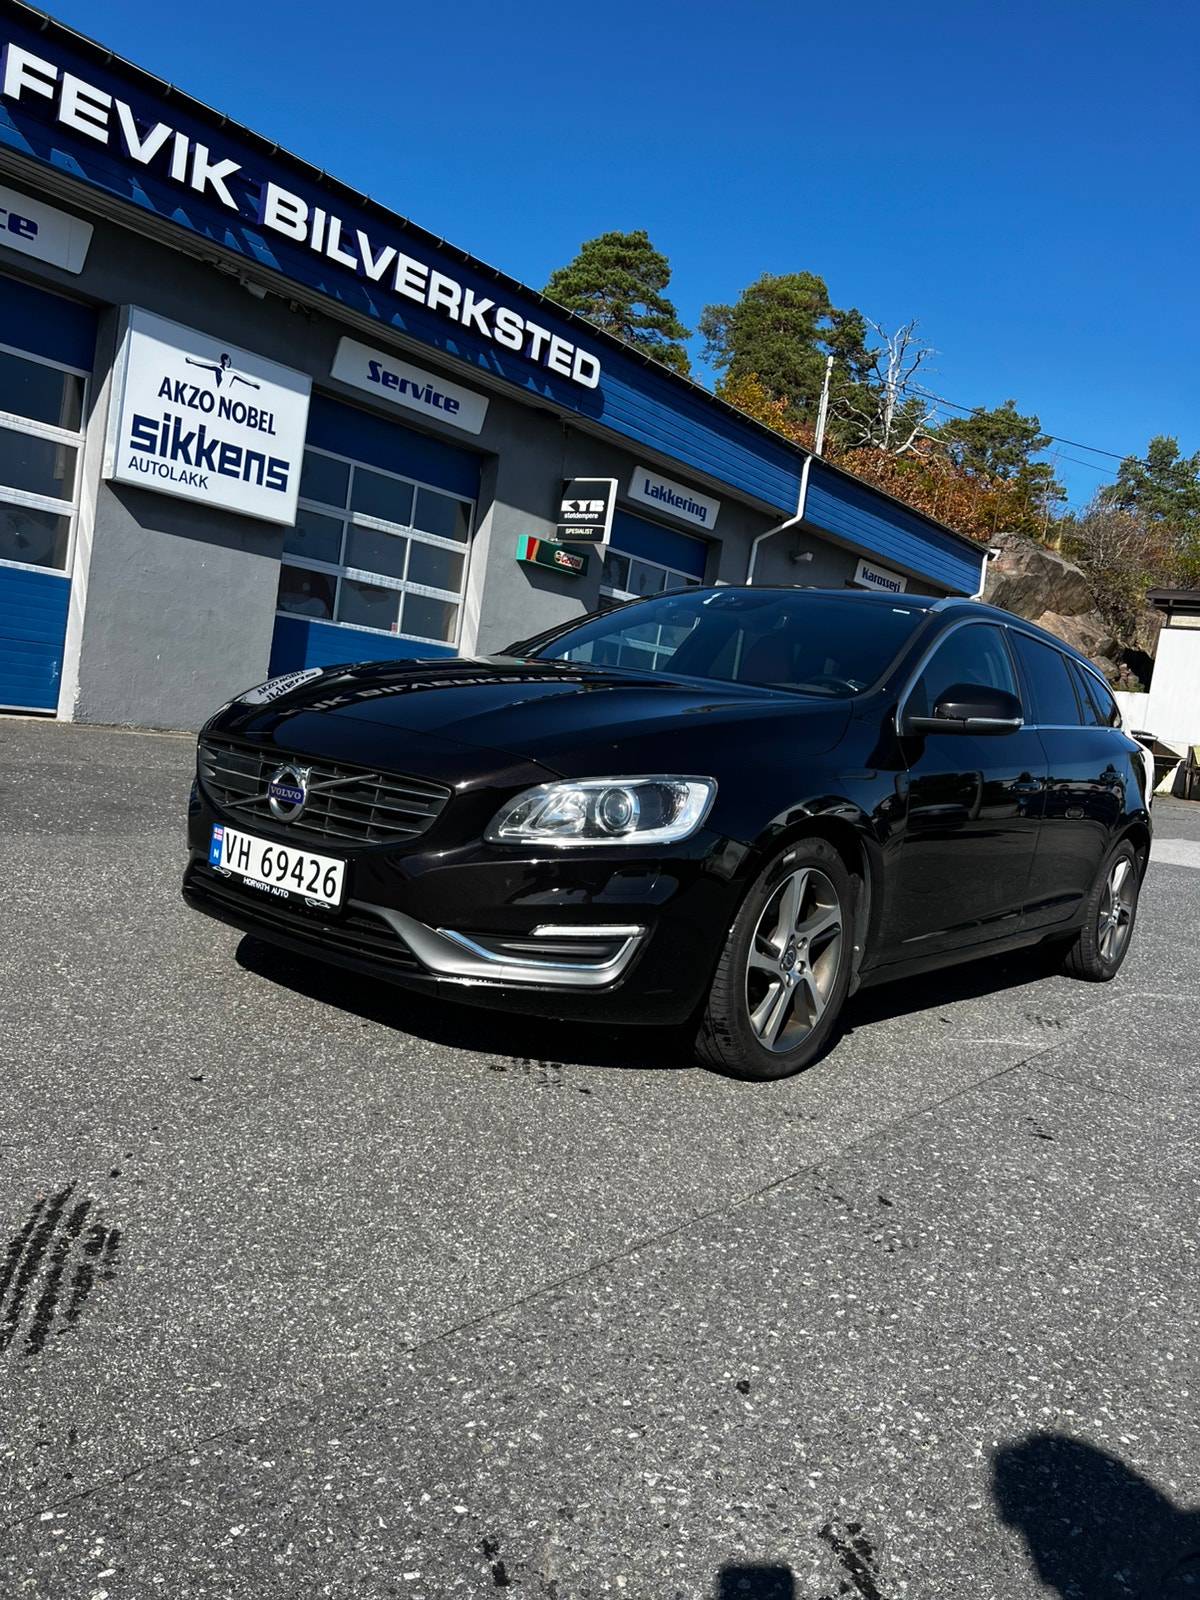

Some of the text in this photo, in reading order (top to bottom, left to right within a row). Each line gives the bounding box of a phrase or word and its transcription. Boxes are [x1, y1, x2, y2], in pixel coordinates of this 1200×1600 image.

[3, 42, 602, 389] FEVIK BILVERKSTED
[157, 376, 276, 436] AKZO NOBEL
[366, 359, 460, 415] Service
[128, 455, 209, 490] AUTOLAKK
[129, 412, 290, 493] sikkens
[560, 499, 605, 512] KYB
[643, 479, 708, 522] Lakkering
[861, 566, 902, 593] Karosseri
[270, 786, 302, 800] VOLVO
[225, 832, 338, 898] VH 69426
[271, 887, 289, 898] AUTO
